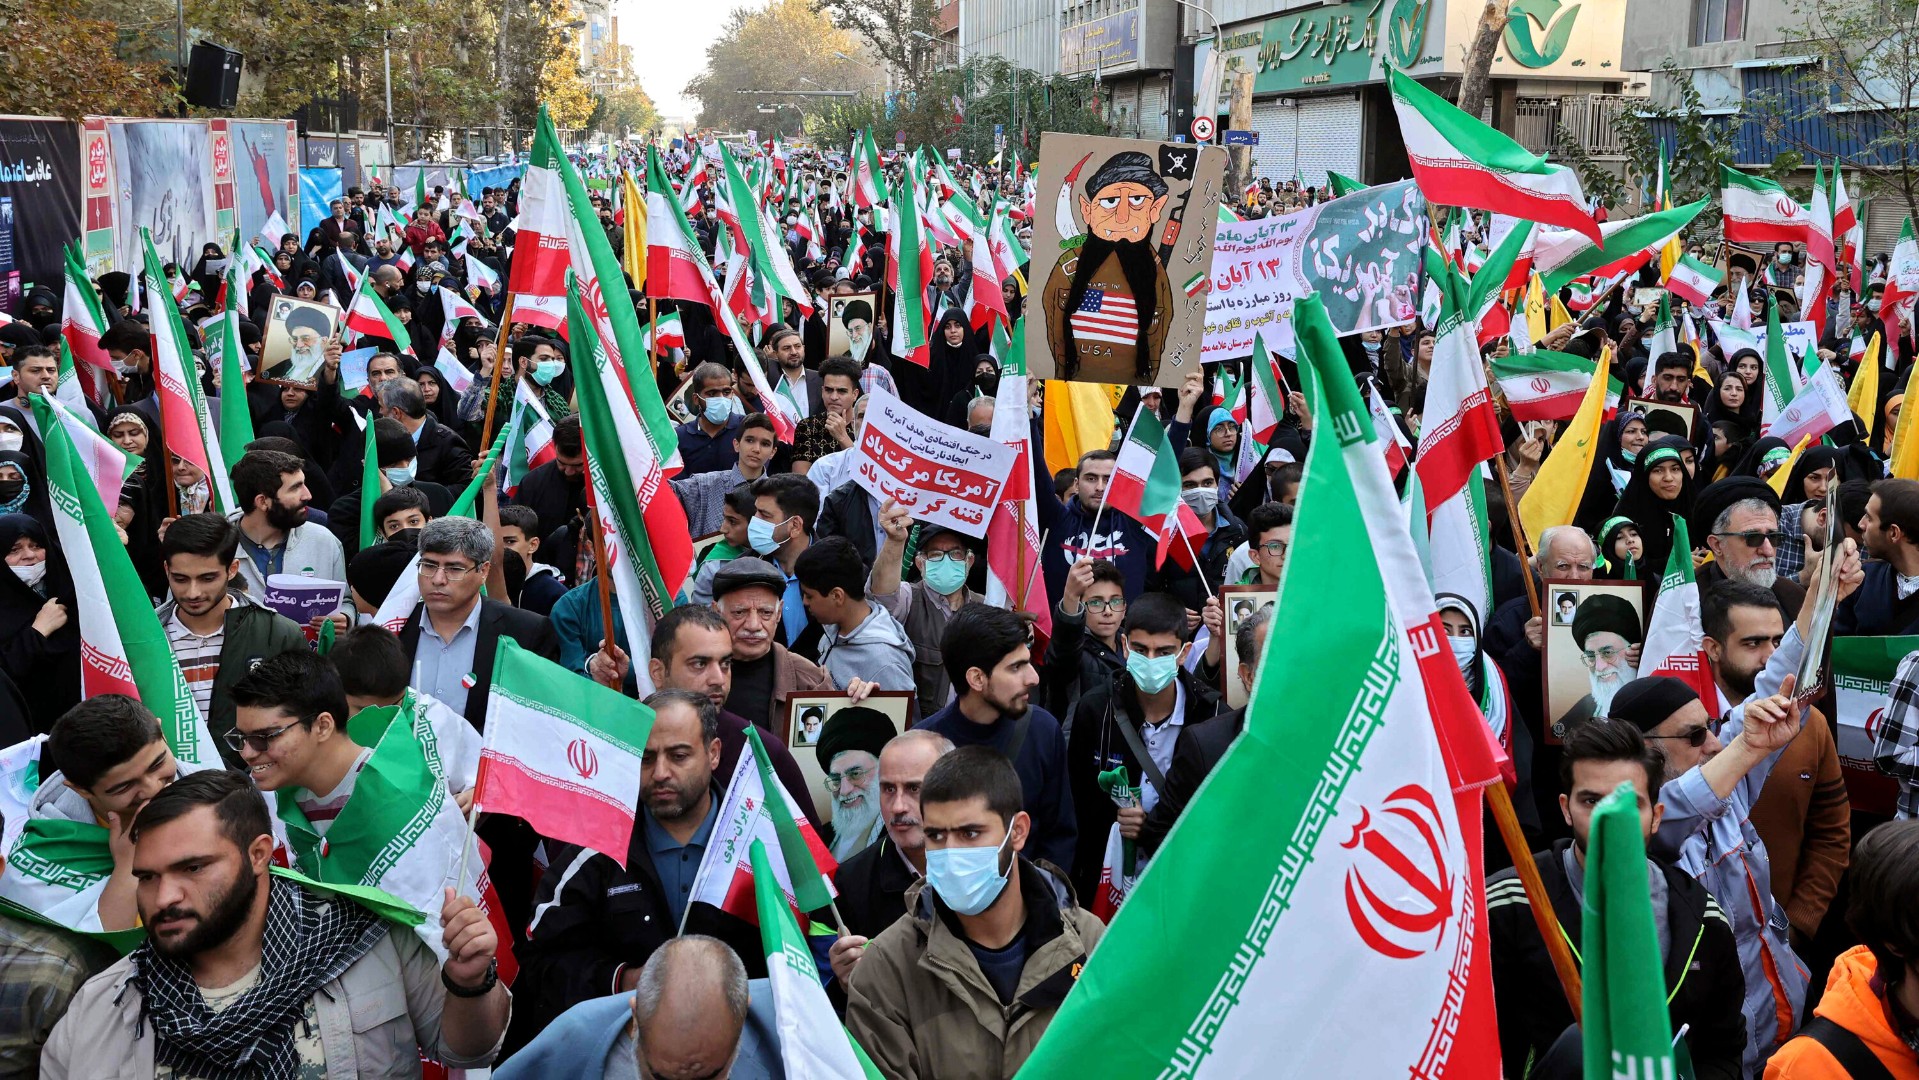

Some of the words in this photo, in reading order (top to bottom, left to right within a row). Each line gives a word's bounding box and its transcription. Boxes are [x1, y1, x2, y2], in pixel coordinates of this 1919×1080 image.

[0, 159, 24, 182] اعتما
[1243, 222, 1277, 244] آبان
[1279, 218, 1298, 233] ۱۳
[1216, 228, 1242, 242] ماه
[1276, 235, 1294, 249] یوم
[1235, 242, 1256, 254] یوم
[1257, 237, 1276, 250] الله
[1217, 260, 1252, 291] آبان
[1257, 257, 1280, 280] ۱۳
[1206, 299, 1225, 311] است
[1226, 297, 1236, 310] با
[1237, 294, 1270, 309] مبارزه
[1272, 292, 1292, 304] روز
[1081, 344, 1112, 357] USA
[884, 406, 906, 426] آمریکا
[895, 431, 912, 446] است
[906, 424, 924, 438] هدف
[865, 433, 885, 462] باد
[924, 433, 960, 451] اقتصادی
[959, 443, 981, 456] جنگ
[911, 441, 946, 460] نارضایتی
[981, 452, 992, 462] در
[884, 448, 930, 484] مرگت
[946, 452, 969, 466] ایجاد
[859, 462, 878, 488] باد
[934, 468, 1001, 500] آمریکا
[880, 480, 919, 506] ننگت
[919, 498, 947, 516] گر
[949, 505, 984, 525] فتنه
[301, 593, 337, 608] سیلی
